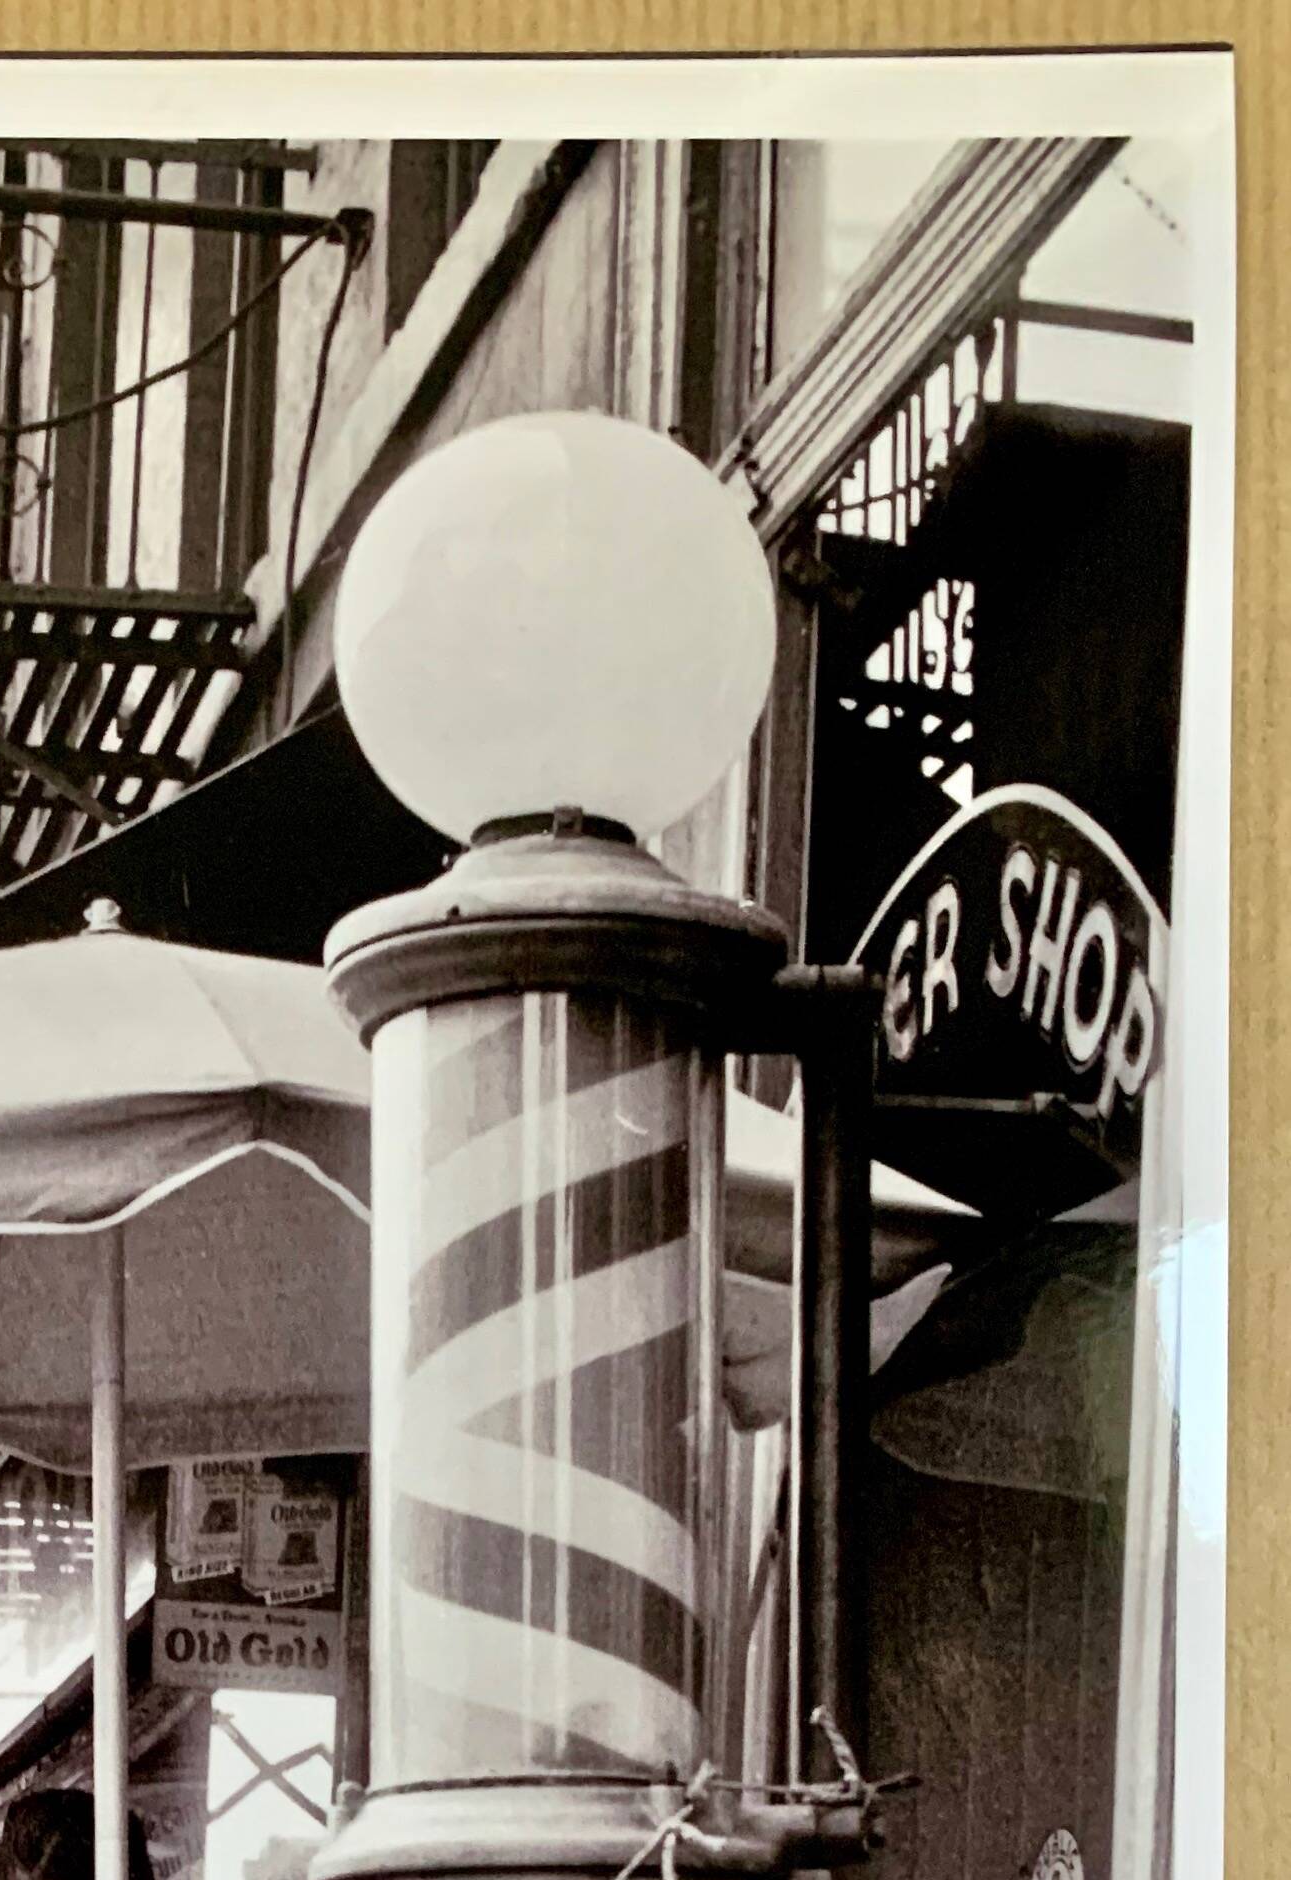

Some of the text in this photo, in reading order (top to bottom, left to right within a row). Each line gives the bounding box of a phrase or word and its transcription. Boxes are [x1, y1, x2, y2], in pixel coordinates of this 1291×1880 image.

[985, 844, 1155, 1120] SHOP
[164, 1627, 330, 1671] Old Gold
